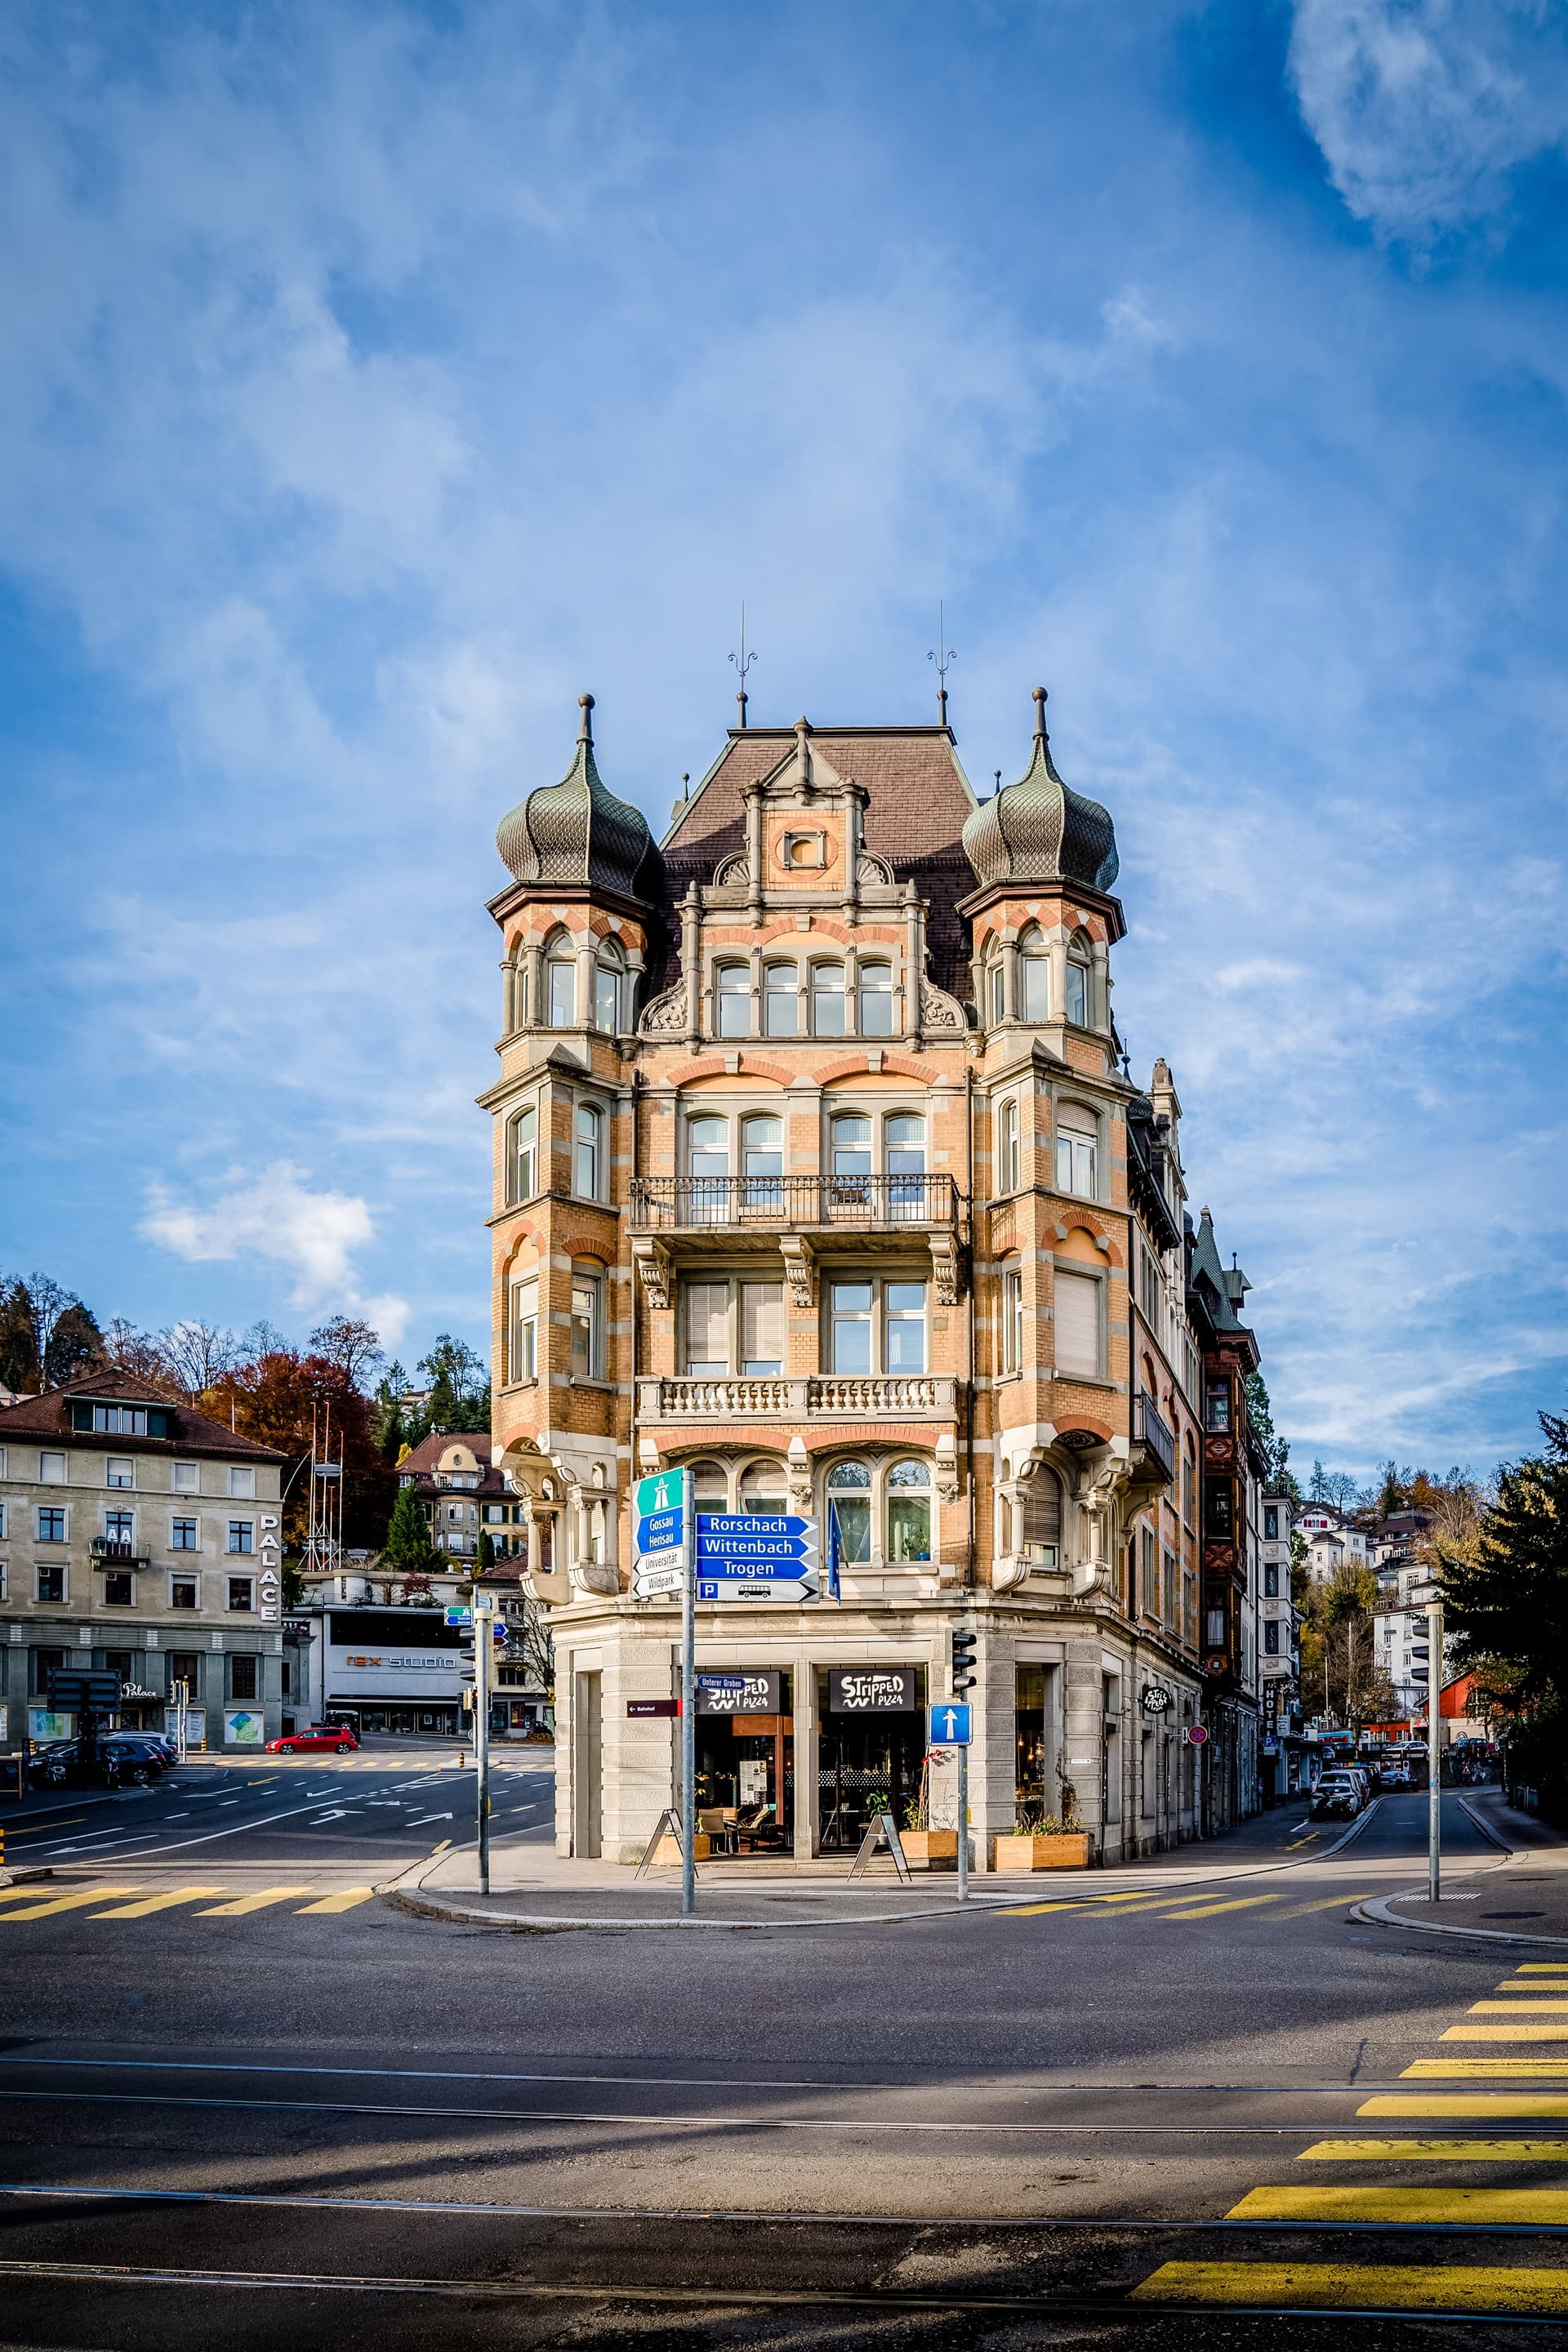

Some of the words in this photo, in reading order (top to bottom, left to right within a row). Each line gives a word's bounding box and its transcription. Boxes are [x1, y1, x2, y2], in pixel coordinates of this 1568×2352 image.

[649, 1516, 674, 1531] Gossau
[710, 1517, 786, 1532] Rorschach
[649, 1532, 674, 1548] Herisau
[705, 1539, 792, 1554] Wittenbach
[645, 1552, 677, 1569] Universität
[259, 1516, 279, 1621] PALACE
[724, 1561, 774, 1578] Trogen
[648, 1573, 675, 1590] Wildpark
[705, 1584, 715, 1597] P
[346, 1655, 381, 1667] rex
[390, 1655, 456, 1668] studio
[122, 1682, 158, 1697] Palace
[702, 1677, 722, 1686] Unterer
[723, 1678, 742, 1687] Graben
[1266, 1737, 1272, 1746] P
